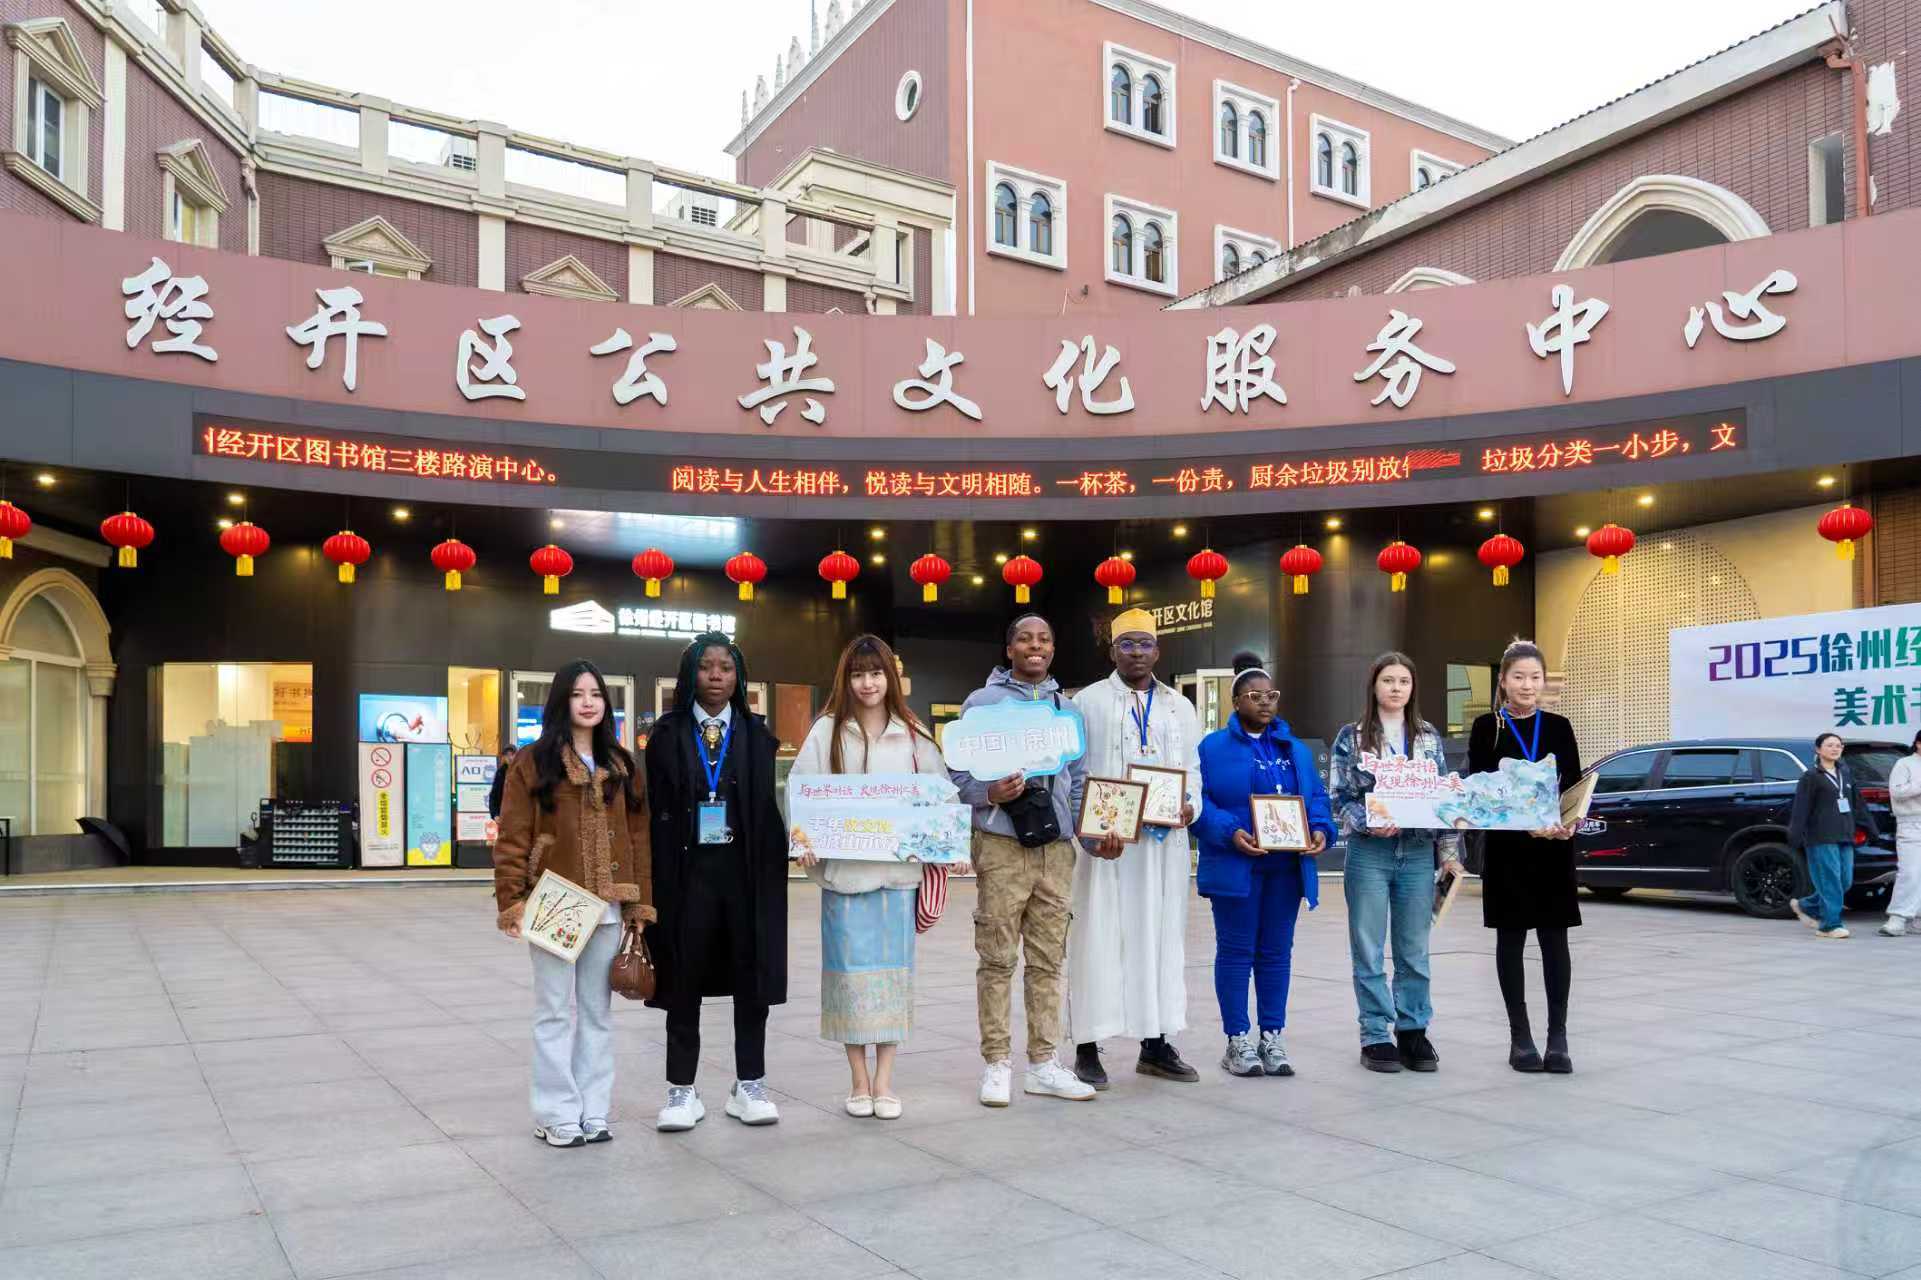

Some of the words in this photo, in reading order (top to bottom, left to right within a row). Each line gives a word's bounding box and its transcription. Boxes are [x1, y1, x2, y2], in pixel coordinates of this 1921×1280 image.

[121, 256, 1799, 425] 经开区公共文化服务中心
[1149, 598, 1214, 627] 开区文化馆
